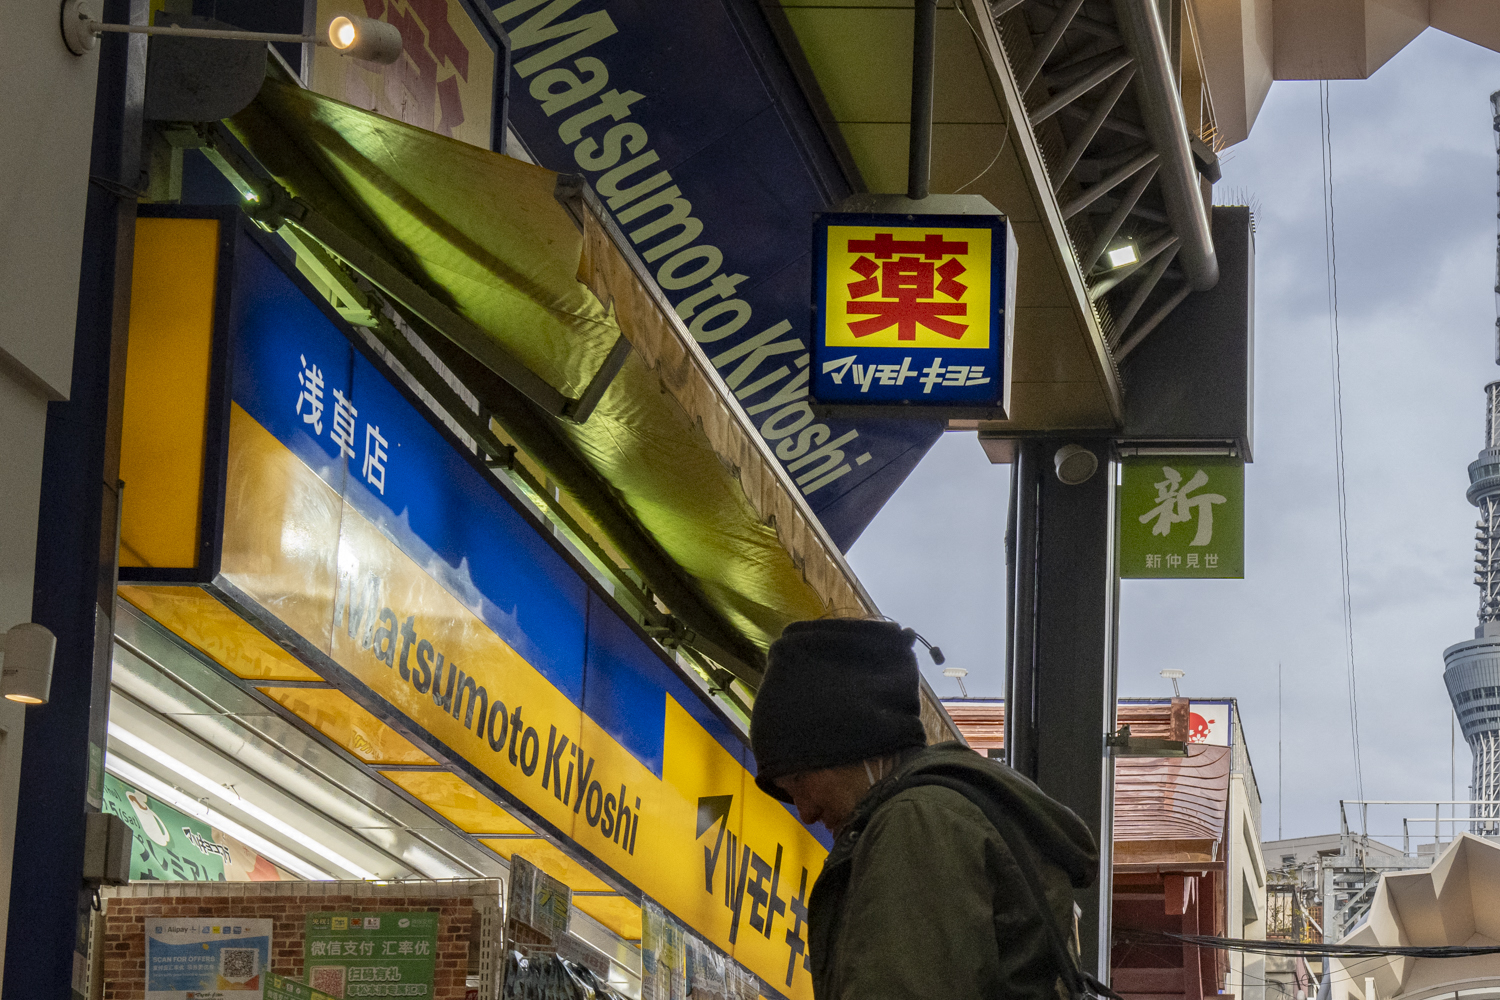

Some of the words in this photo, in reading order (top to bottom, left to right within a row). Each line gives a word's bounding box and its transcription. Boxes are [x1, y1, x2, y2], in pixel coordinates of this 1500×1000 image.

[490, 0, 752, 343] Matsumoto
[846, 233, 970, 341] 薬
[822, 355, 991, 393] マツモトキヨシ
[296, 353, 388, 496] 浅草店
[1138, 465, 1228, 547] 新
[1145, 553, 1219, 569] 新仲見世
[333, 567, 540, 777] Matsumoto
[311, 941, 375, 956] 微信支付
[381, 941, 430, 956] 汇率优
